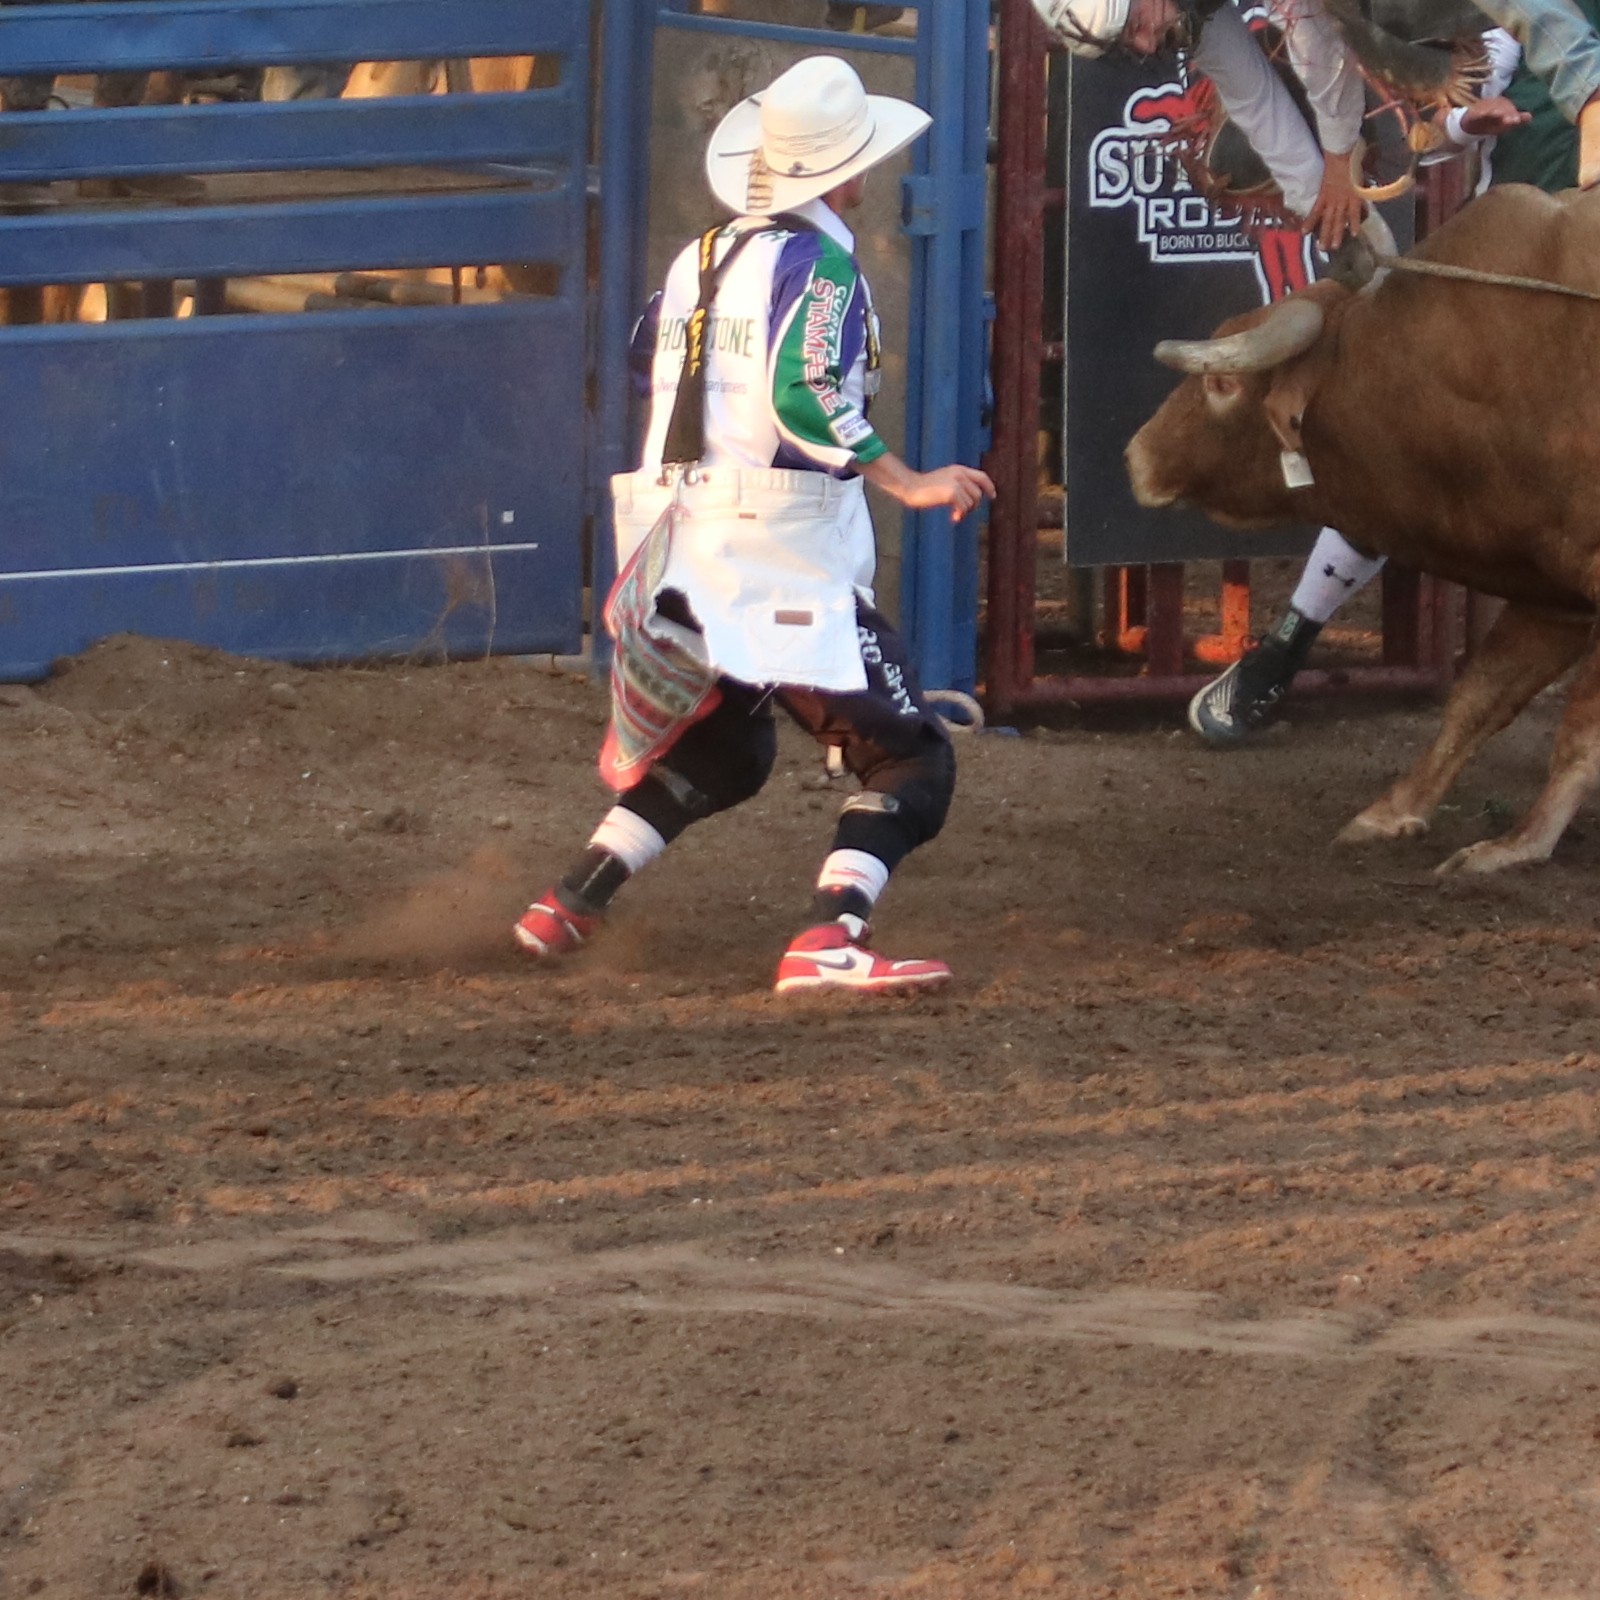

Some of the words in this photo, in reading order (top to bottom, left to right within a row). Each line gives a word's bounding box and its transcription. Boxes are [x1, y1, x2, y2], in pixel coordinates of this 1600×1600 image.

[1159, 233, 1196, 250] BORN
[1197, 233, 1215, 249] TO
[803, 277, 847, 418] STAMPEDE
